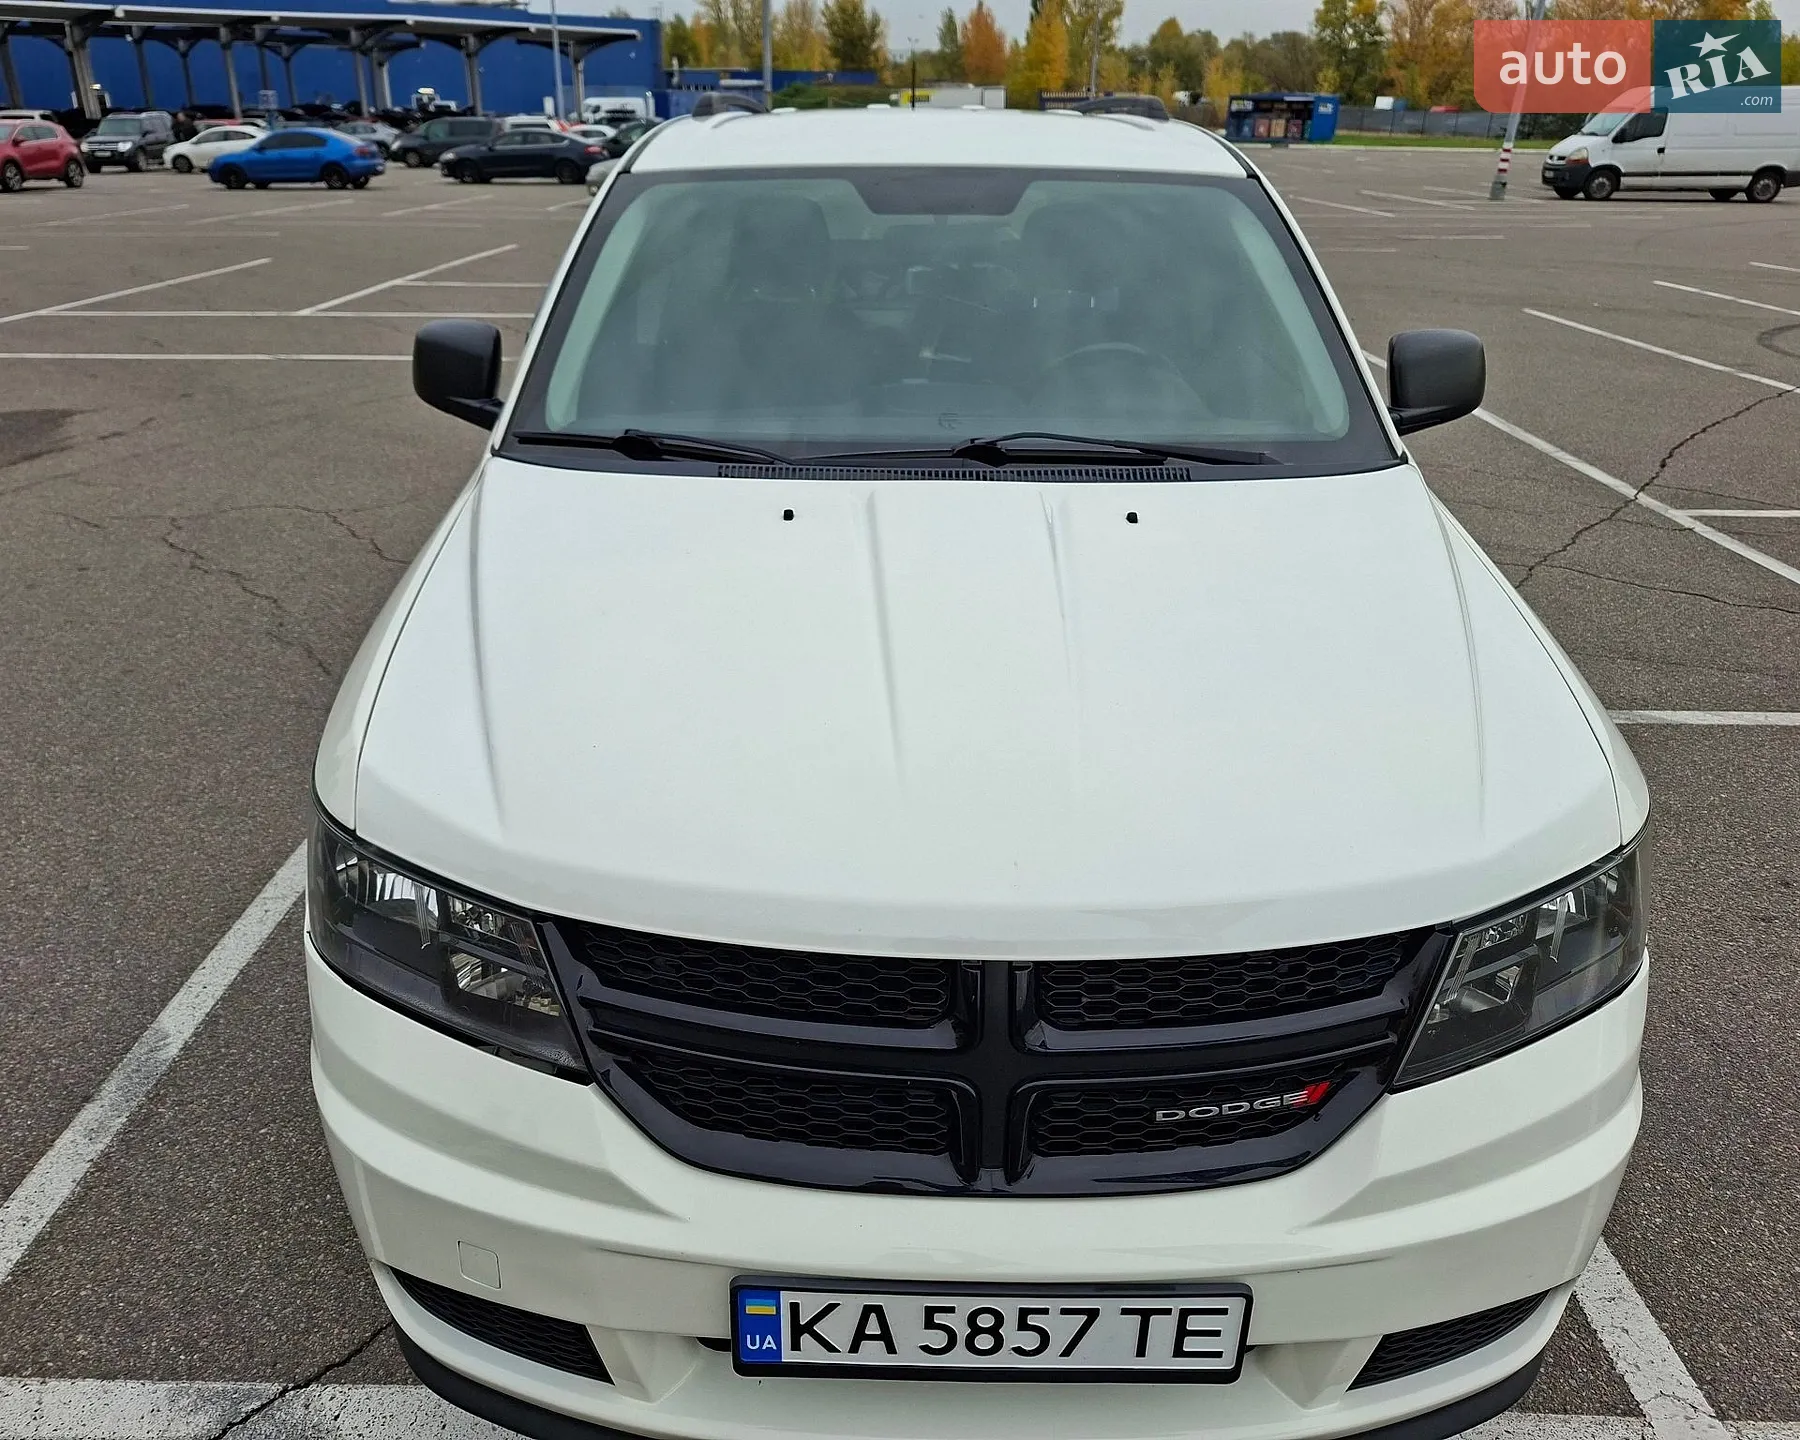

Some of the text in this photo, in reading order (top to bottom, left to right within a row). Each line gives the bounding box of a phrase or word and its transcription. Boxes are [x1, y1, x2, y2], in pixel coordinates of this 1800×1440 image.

[1155, 1090, 1309, 1122] DODGE
[746, 1333, 777, 1351] UA
[788, 1300, 1230, 1359] KA 5857 TE
